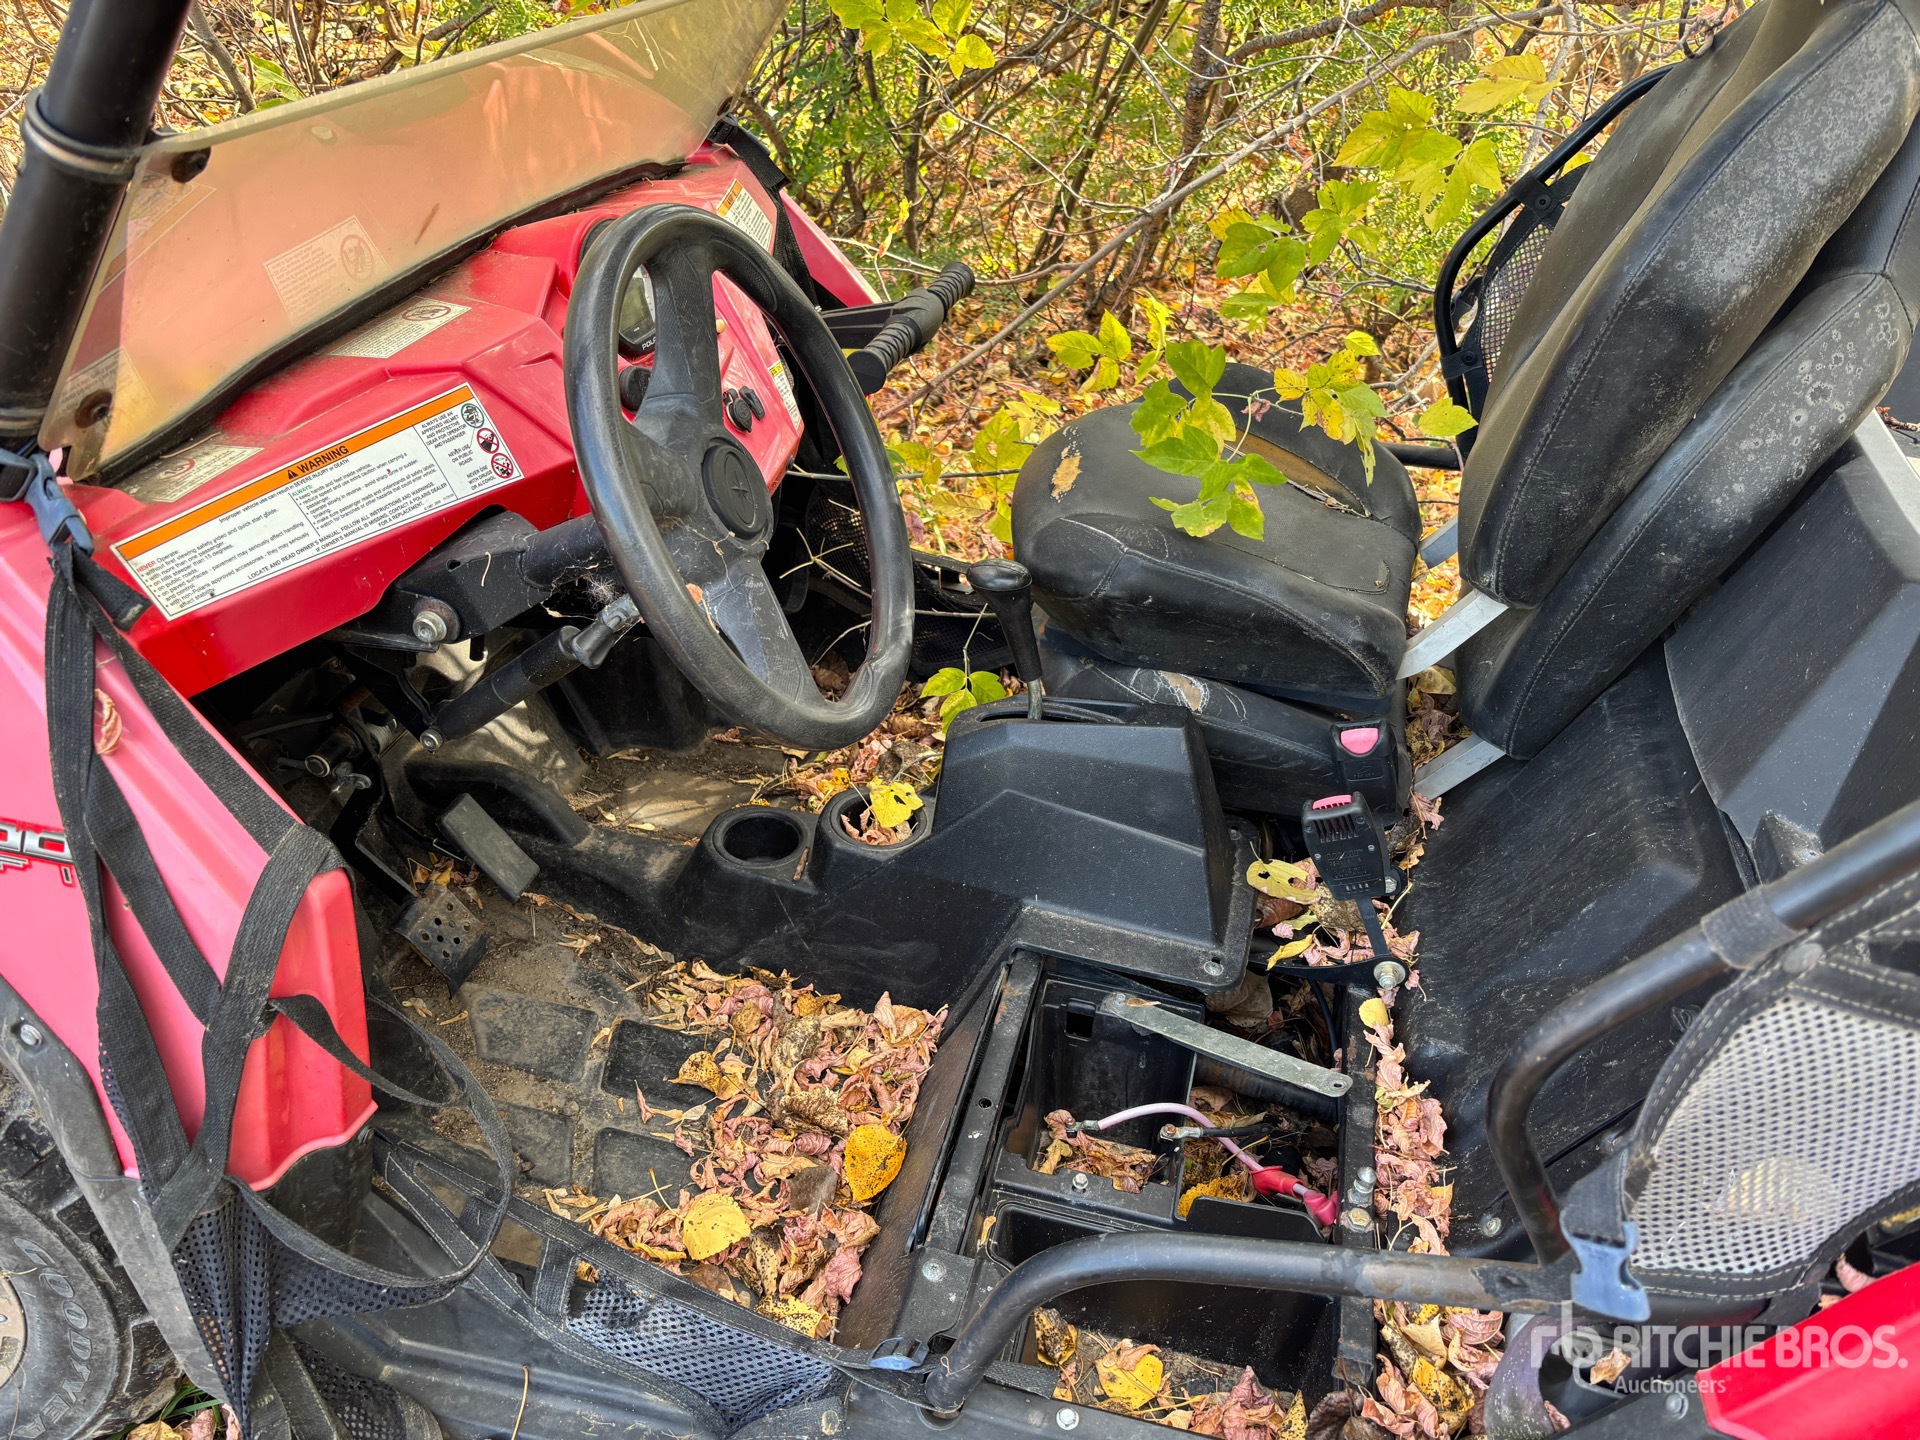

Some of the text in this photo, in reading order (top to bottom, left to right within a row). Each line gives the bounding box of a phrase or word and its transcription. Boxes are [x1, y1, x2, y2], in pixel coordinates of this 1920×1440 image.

[421, 418, 439, 429] ALWAYS
[421, 415, 459, 435] APPROVED HELMET
[426, 421, 460, 440] AND PROTECTIVE
[426, 438, 438, 446] GEAR
[446, 424, 467, 436] OPERATOR
[442, 431, 466, 445] PASSENGER
[297, 446, 349, 474] WARNING
[447, 449, 462, 458] NEVER
[458, 450, 474, 460] PUBLIC
[458, 457, 473, 467] ROADS
[302, 495, 319, 505] reduce
[318, 488, 333, 498] speed
[349, 475, 361, 483] extra
[360, 467, 377, 477] caution
[376, 462, 388, 470] when
[387, 454, 405, 465] carrying
[466, 465, 489, 479] NEVER USE
[468, 470, 493, 485] WITH DRUGS
[477, 476, 496, 487] ALCOHOL
[218, 510, 242, 524] Improper
[242, 502, 259, 512] vehicle
[276, 487, 290, 496] result
[294, 477, 313, 488] SEVERE
[311, 469, 329, 479] INJURY
[333, 459, 350, 469] DEATH
[298, 493, 311, 501] keep
[310, 486, 325, 495] hands
[342, 471, 356, 480] inside
[309, 504, 328, 515] operate
[326, 497, 342, 507] slowly
[345, 487, 362, 497] reverse
[364, 480, 376, 488] avoid
[375, 474, 389, 483] sharp
[403, 459, 419, 469] sudden
[316, 516, 329, 524] make
[339, 500, 361, 514] passenger
[361, 494, 373, 502] reads
[381, 478, 406, 492] understands
[410, 469, 424, 478] safety
[319, 520, 334, 529] watch
[340, 506, 360, 519] branches
[365, 498, 376, 506] other
[376, 491, 393, 501] hazards
[400, 480, 413, 489] could
[320, 536, 344, 550] OWNER'S
[343, 526, 363, 539] MANUAL
[388, 502, 409, 516] CONTACT
[412, 491, 431, 503] POLARIS
[430, 483, 448, 494] DEALER
[378, 520, 389, 528] FOR
[144, 564, 165, 576] without
[164, 558, 176, 566] first
[176, 548, 197, 561] viewing
[196, 541, 213, 551] safety
[212, 533, 227, 543] video
[227, 528, 238, 536] and
[237, 521, 252, 531] quick
[251, 515, 263, 524] start
[247, 567, 270, 580] LOCATE
[269, 560, 282, 569] AND
[281, 553, 296, 563] READ
[295, 541, 320, 556] OWNER'S
[340, 519, 361, 532] FOLLOW
[360, 515, 370, 523] ALL
[369, 498, 402, 518] INSTRUCTIONS
[401, 493, 412, 501] AND
[136, 561, 157, 574] NEVER
[148, 573, 161, 581] with
[161, 567, 175, 576] more
[174, 560, 188, 568] than
[160, 575, 172, 583] hills
[172, 564, 193, 577] steeper
[192, 558, 205, 567] than
[168, 581, 187, 594] paved
[185, 570, 209, 584] surfaces
[211, 555, 238, 572] pavement
[237, 551, 249, 559] may
[248, 539, 270, 553] seriously
[169, 598, 182, 607] with
[210, 570, 236, 586] approved
[234, 556, 264, 573] accessories
[266, 548, 279, 557] they
[278, 543, 289, 551] may
[288, 532, 310, 546] seriously
[164, 577, 182, 589] public
[165, 594, 177, 602] and
[13, 1236, 93, 1439] GOODYEA
